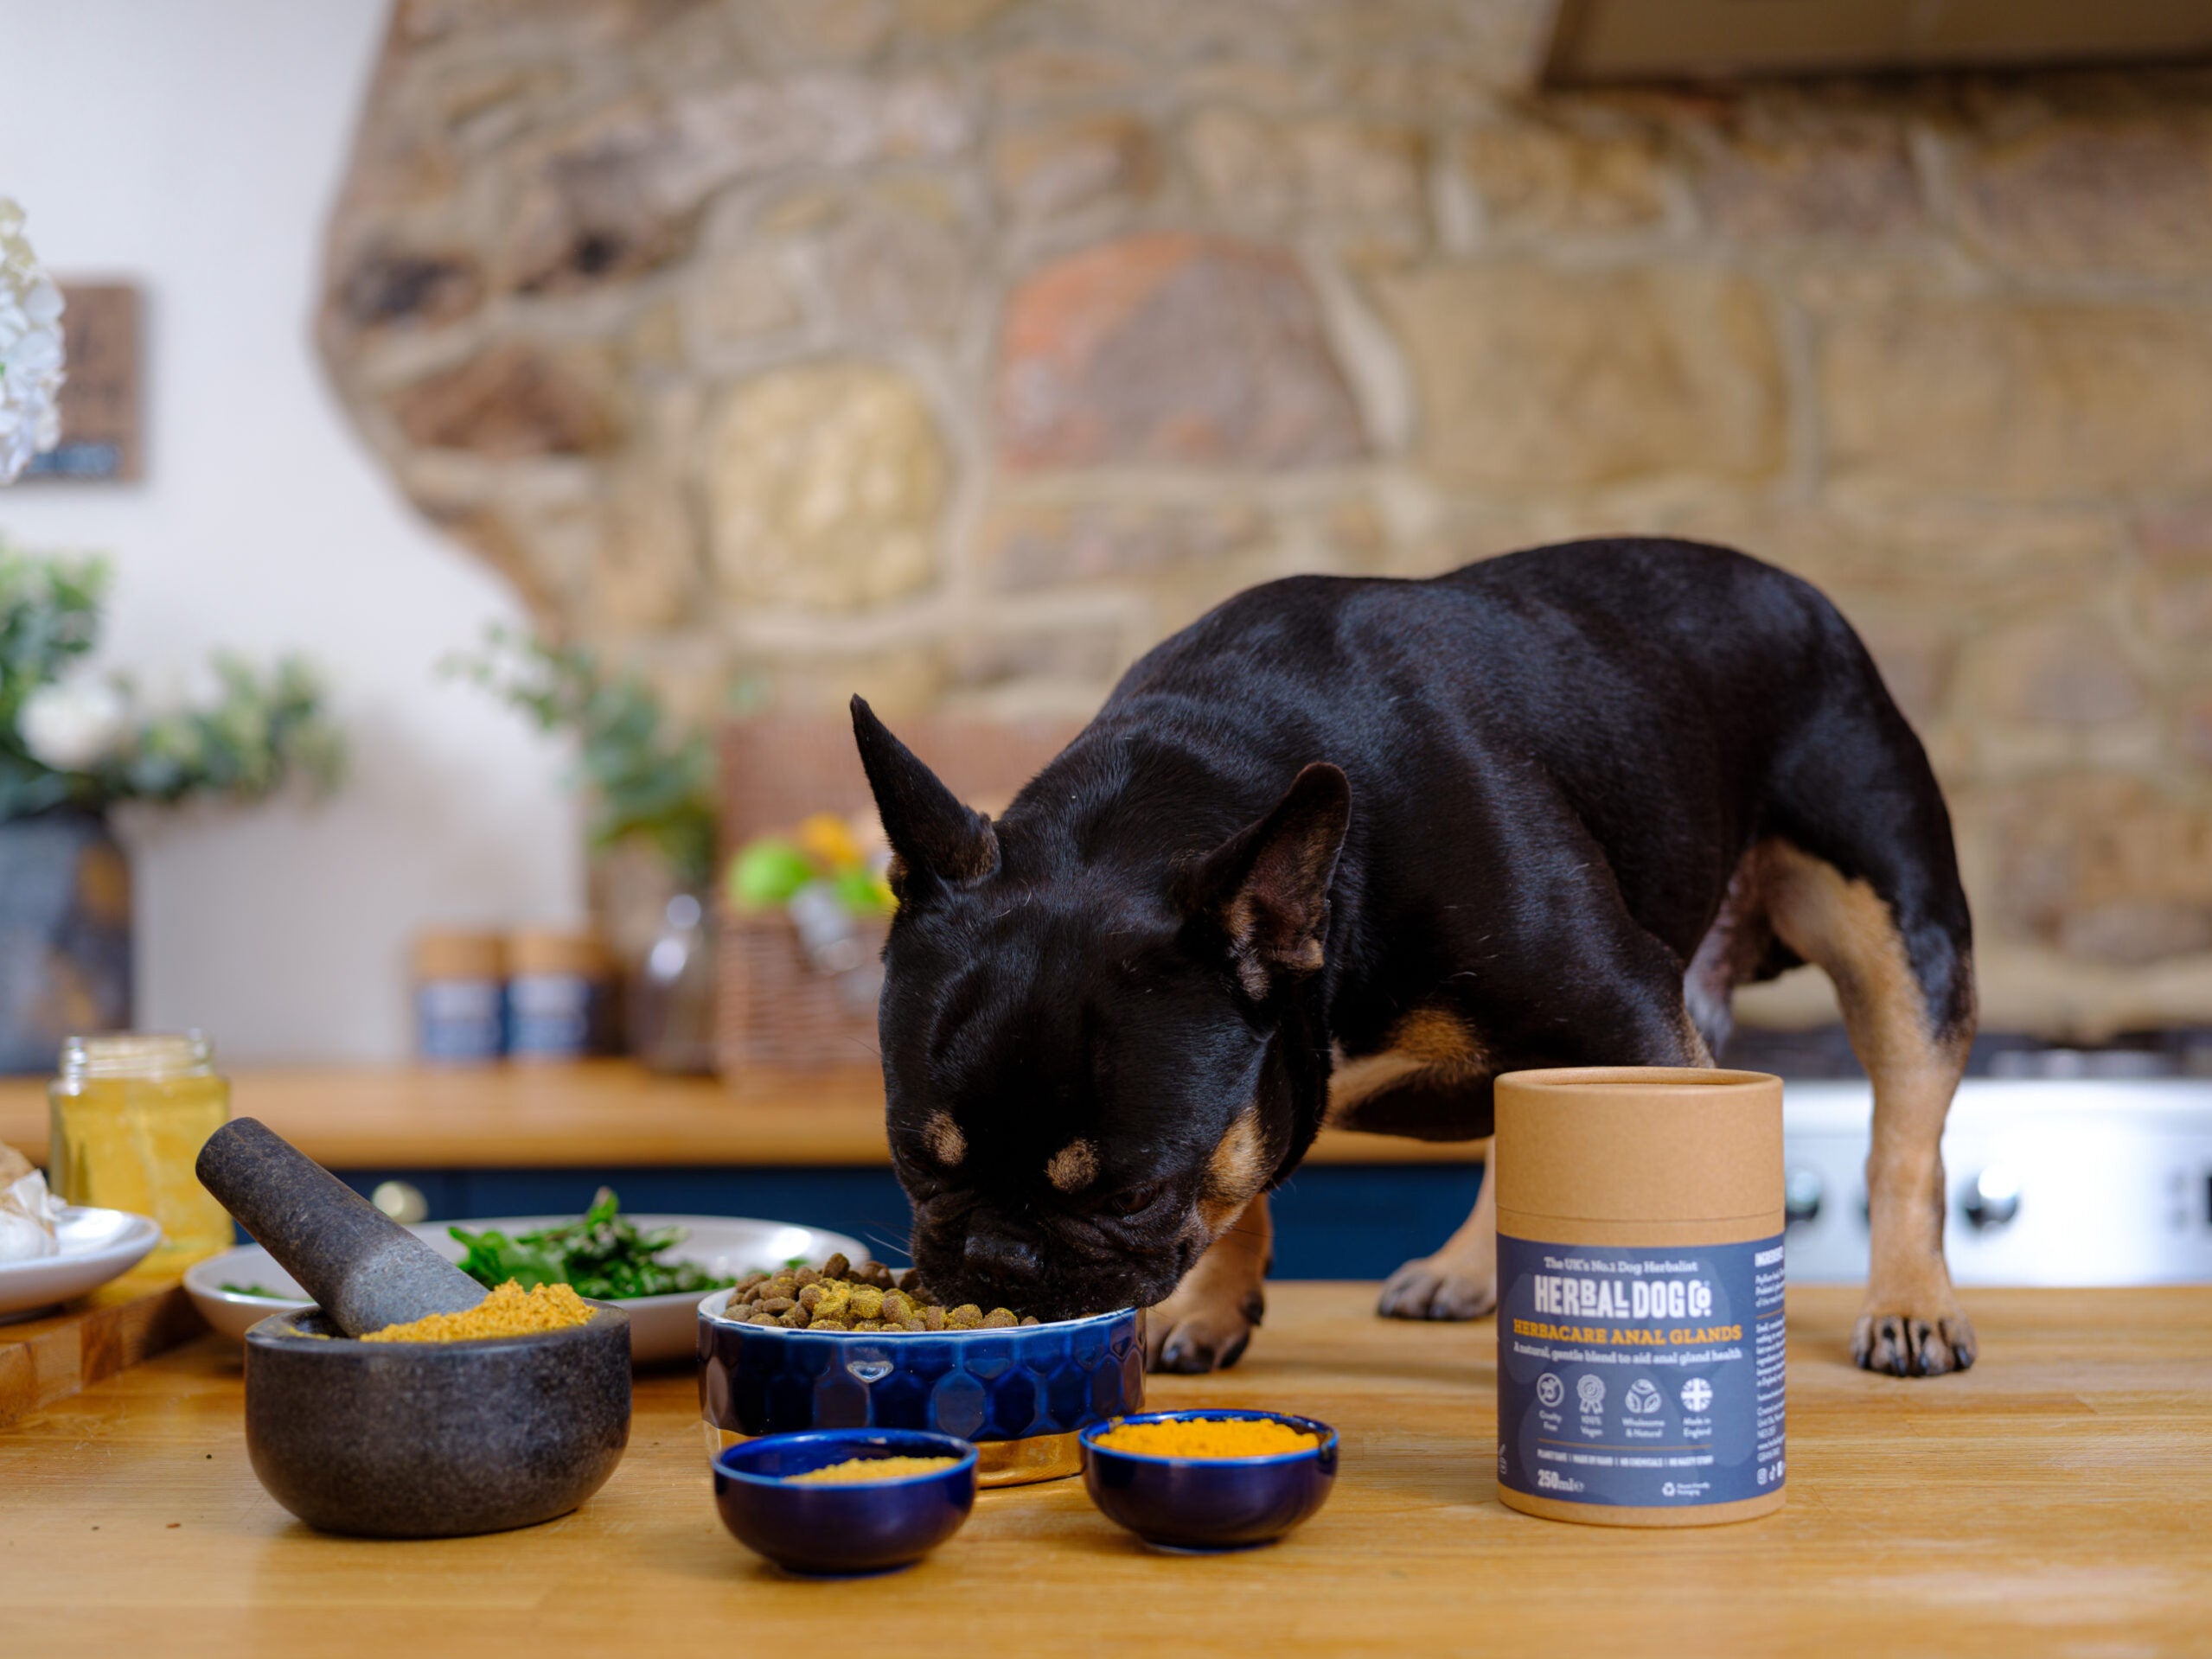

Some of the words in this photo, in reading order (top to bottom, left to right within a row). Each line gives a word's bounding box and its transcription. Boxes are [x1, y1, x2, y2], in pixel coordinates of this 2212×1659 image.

[1544, 1256, 1563, 1270] The
[1564, 1258, 1589, 1272] UK's
[1591, 1260, 1615, 1273] No.1
[1617, 1260, 1642, 1276] Dog
[1644, 1259, 1698, 1273] Herbalist
[1534, 1274, 1630, 1318] HERBAL
[1633, 1280, 1685, 1318] DOG
[1513, 1318, 1607, 1344] HERBACARE
[1610, 1328, 1666, 1345] ANAL
[1669, 1324, 1742, 1345] GLANDS
[1513, 1341, 1519, 1352] A
[1551, 1349, 1583, 1362] gentle
[1584, 1350, 1616, 1363] blend
[1618, 1352, 1631, 1364] to
[1633, 1351, 1651, 1364] aid
[1653, 1351, 1678, 1364] anal
[1679, 1350, 1710, 1366] gland
[1711, 1347, 1742, 1362] health
